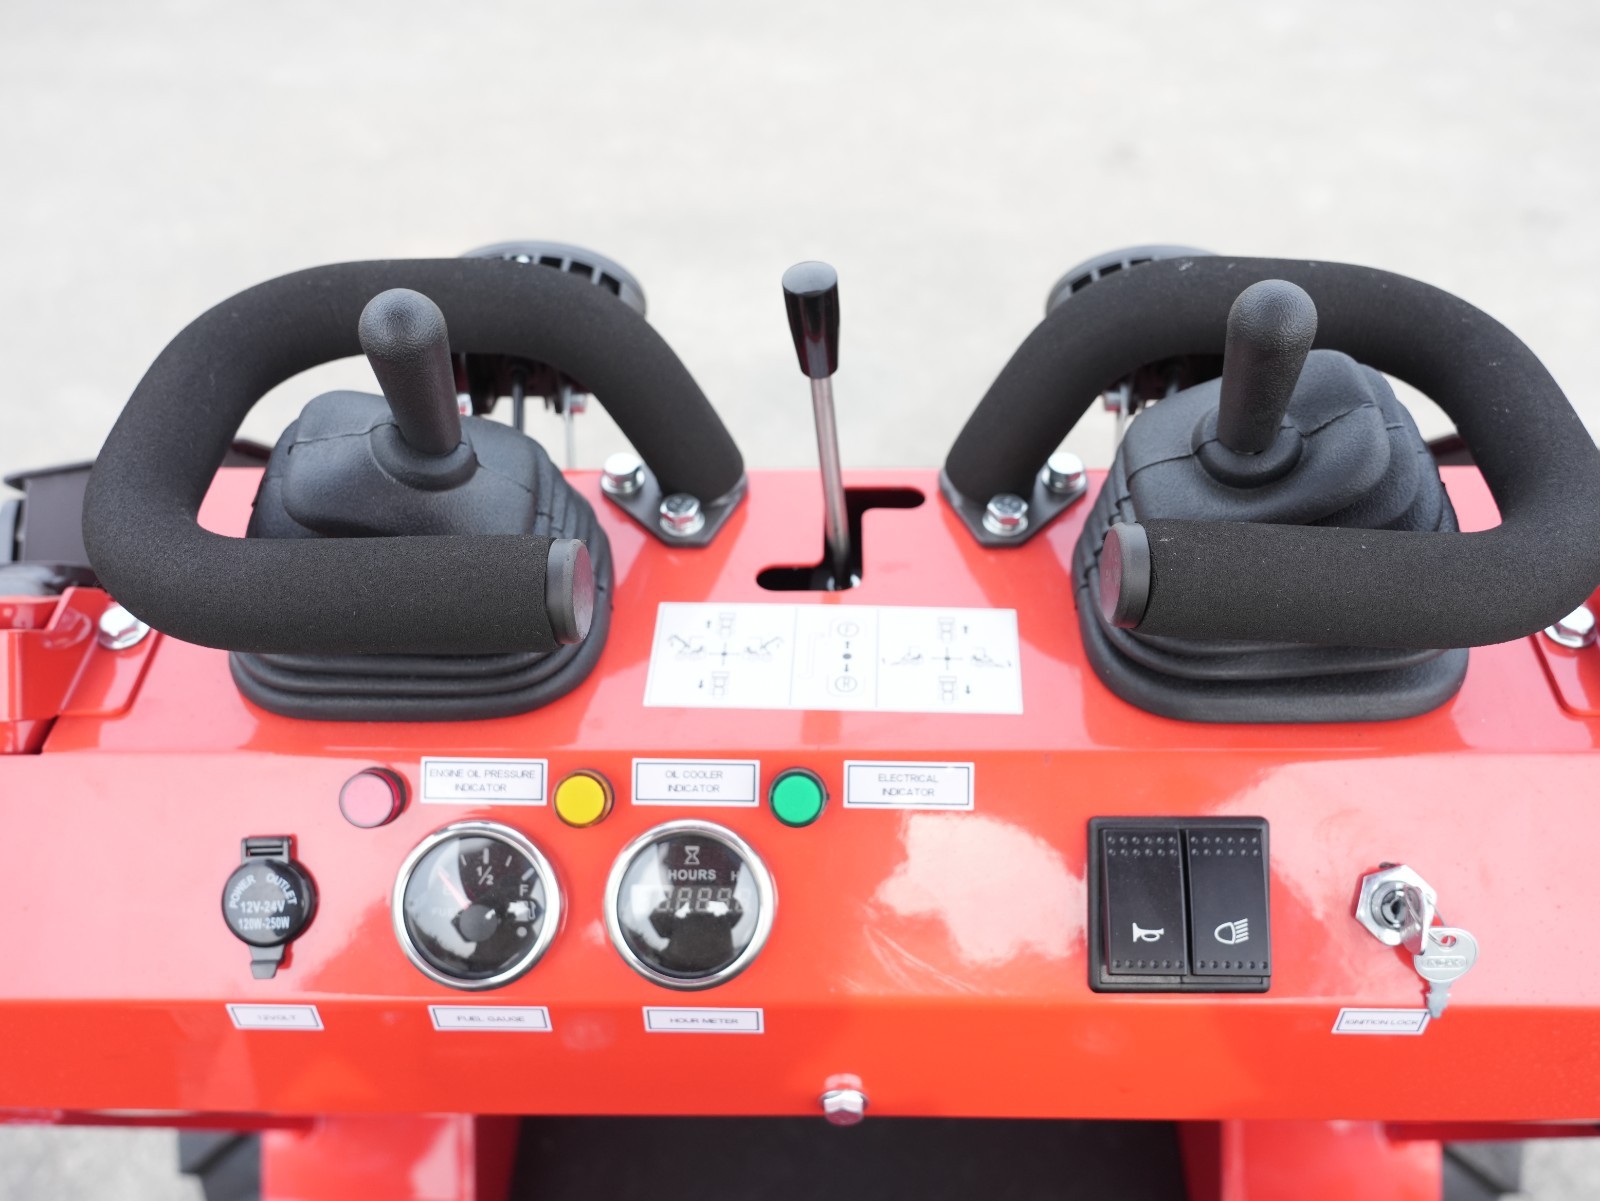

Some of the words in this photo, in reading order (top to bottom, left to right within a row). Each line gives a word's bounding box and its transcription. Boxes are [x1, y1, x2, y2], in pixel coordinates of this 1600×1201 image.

[429, 767, 464, 777] ENGINE
[467, 769, 480, 778] OIL
[485, 769, 536, 779] PRESSURE
[665, 770, 679, 779] OIL
[682, 770, 723, 779] COOLER
[878, 773, 939, 783] ELECTRICAL
[455, 783, 507, 792] INDICATOR
[668, 784, 720, 793] INDICATOR
[882, 787, 935, 797] INDICATOR
[668, 868, 717, 881] HOURS
[228, 874, 257, 909] POWER
[266, 872, 298, 905] OUTLET
[519, 884, 529, 897] F
[240, 899, 286, 913] 12V-24V
[238, 915, 290, 930] 120W-250W
